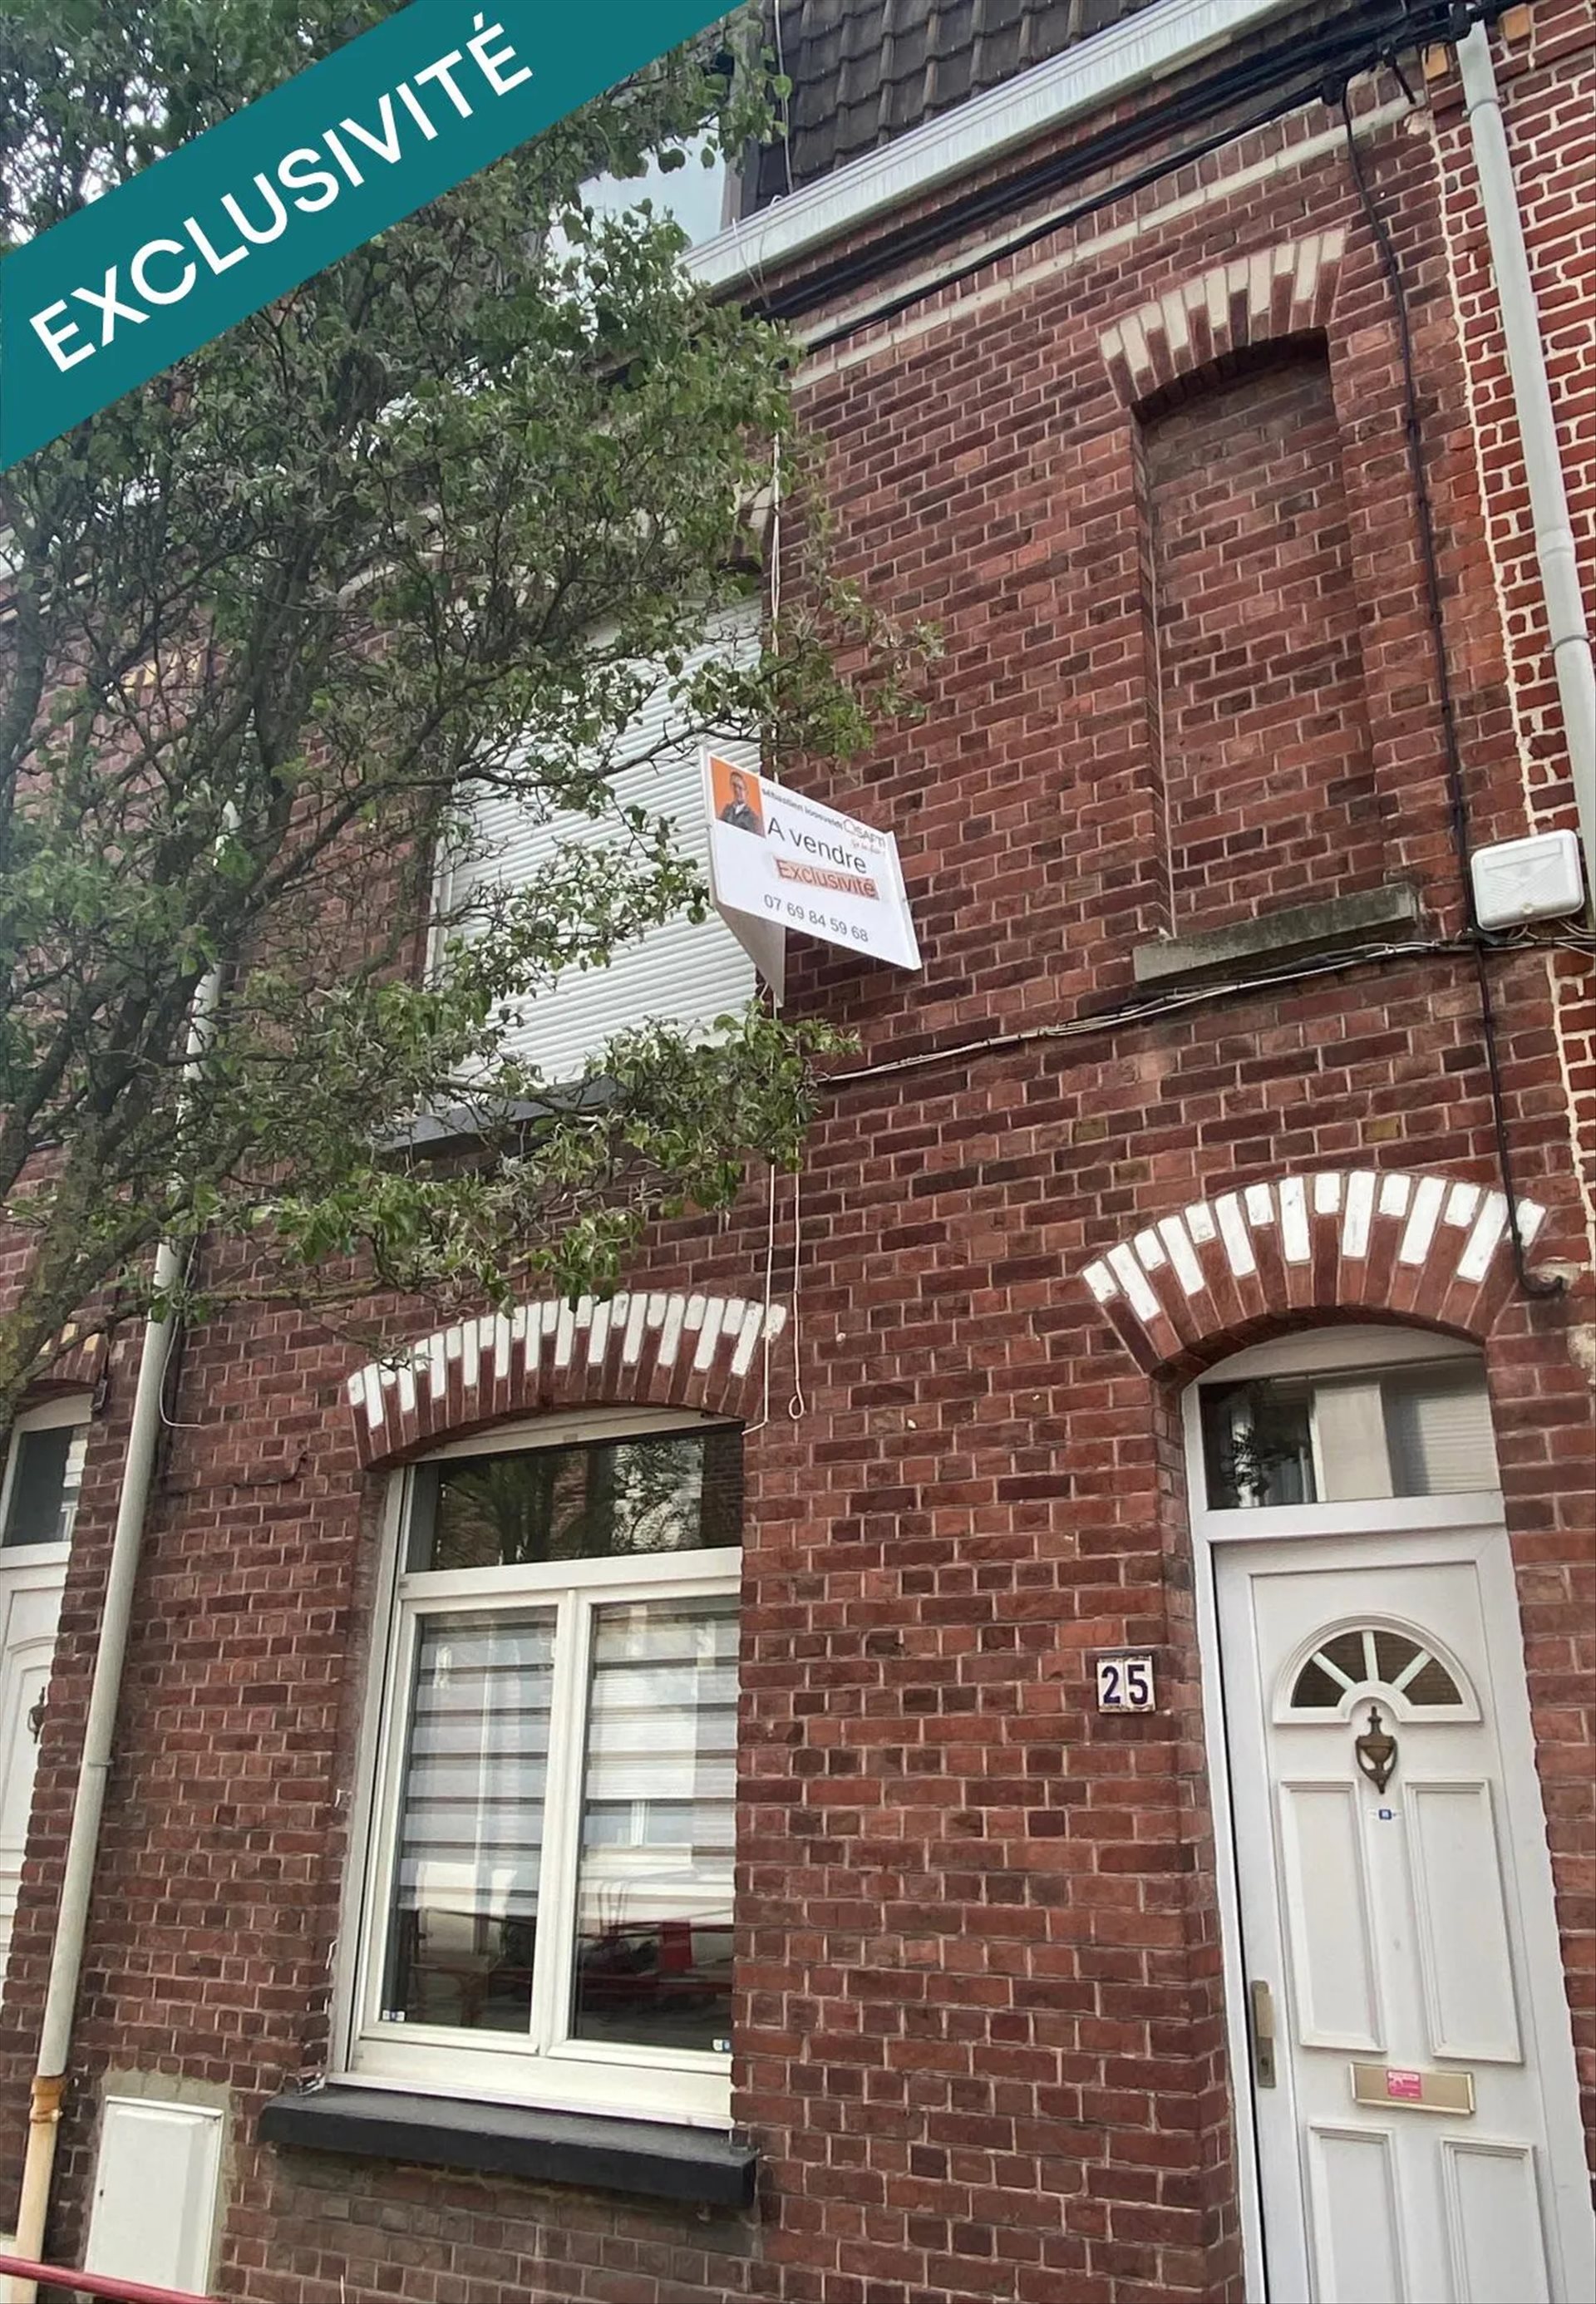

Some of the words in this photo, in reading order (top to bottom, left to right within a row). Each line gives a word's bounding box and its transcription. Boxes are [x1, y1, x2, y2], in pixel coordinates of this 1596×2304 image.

[767, 817, 786, 841] A
[789, 829, 867, 874] vendre
[776, 859, 876, 898] Exclusivité
[764, 894, 781, 911] 07
[787, 902, 805, 920] 69
[809, 910, 826, 928] 84
[830, 918, 848, 935] 59
[851, 925, 869, 943] 68
[1101, 1664, 1148, 1705] 25
